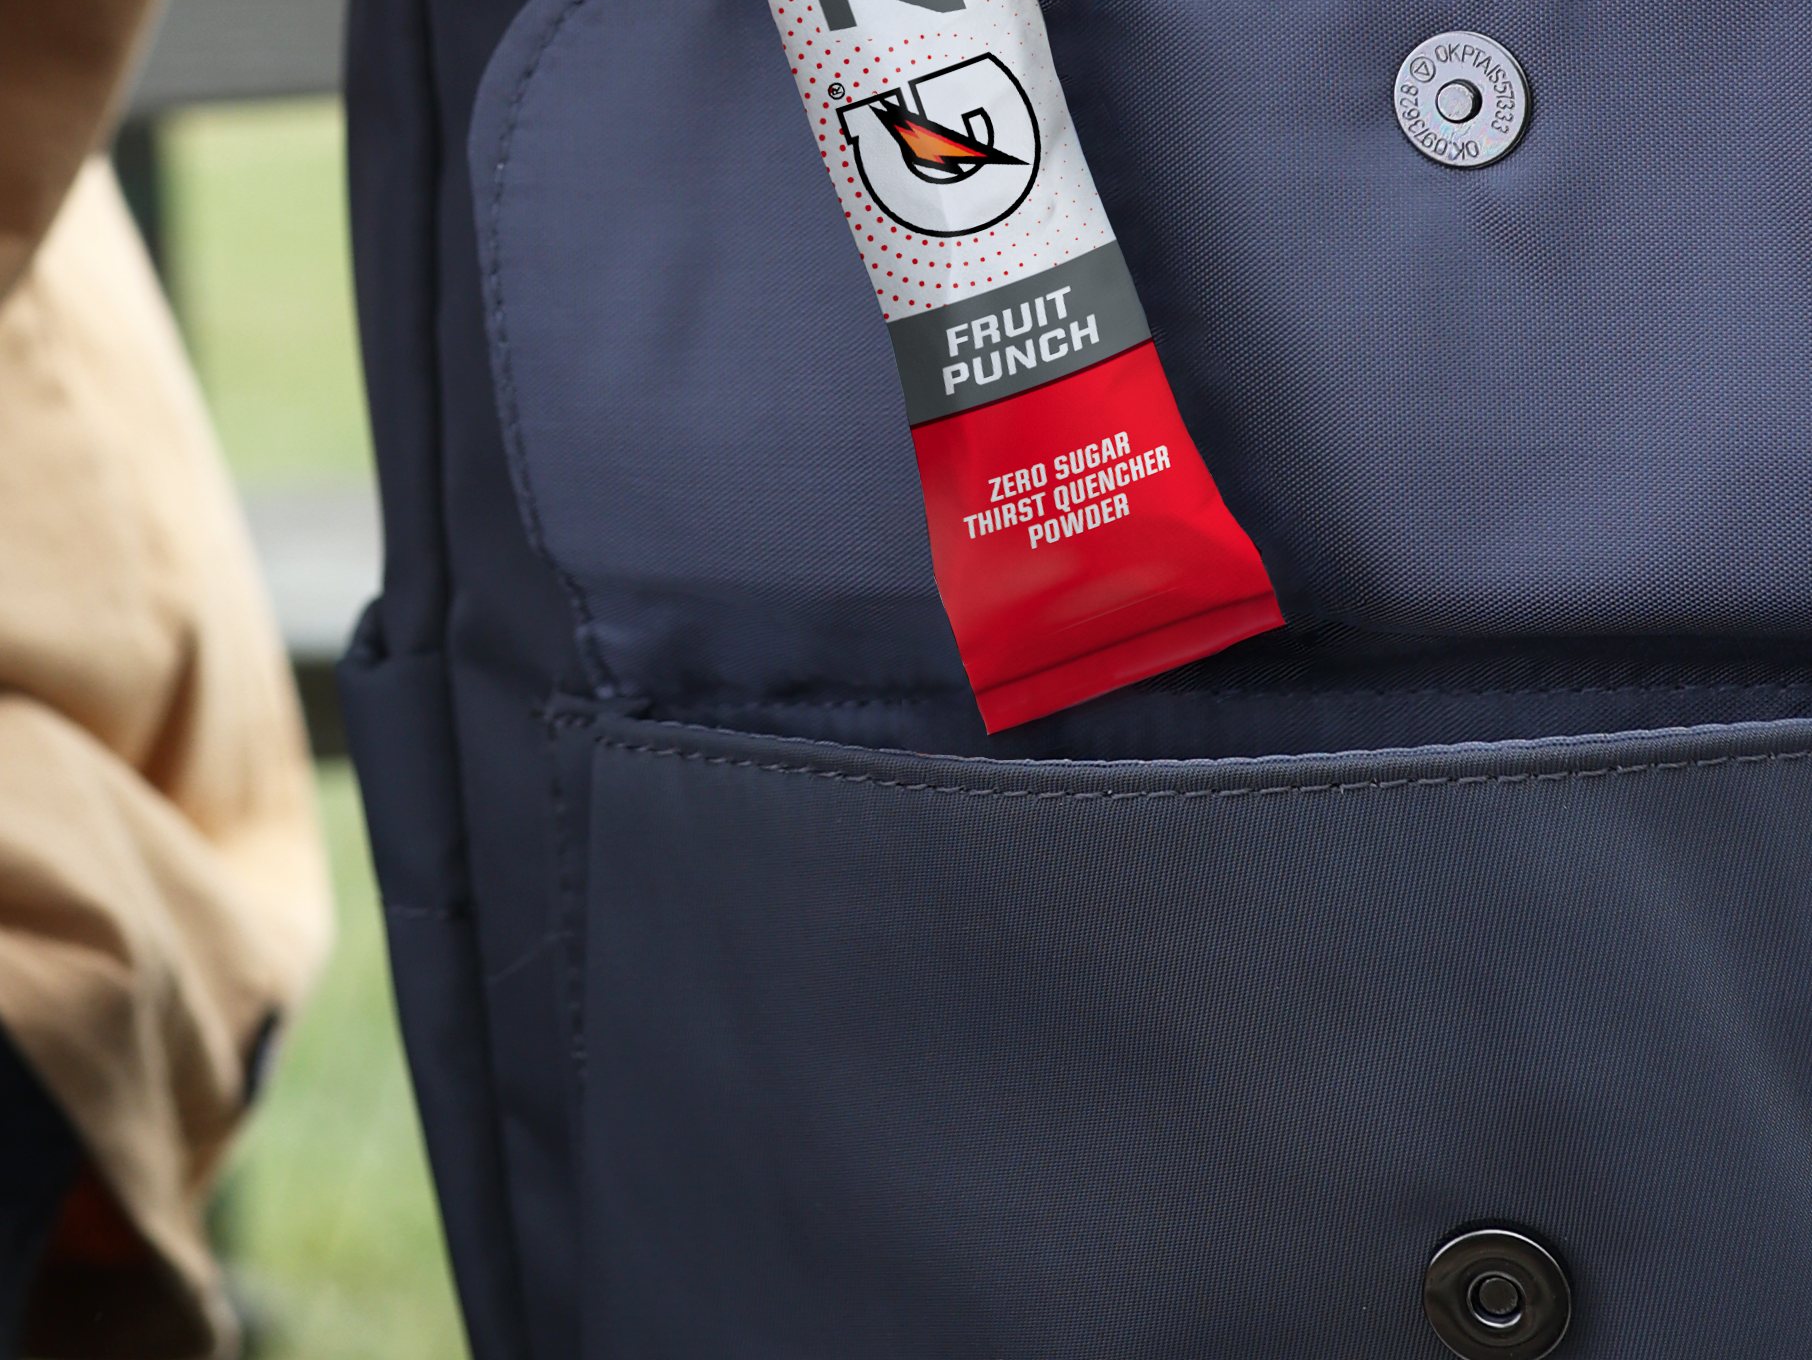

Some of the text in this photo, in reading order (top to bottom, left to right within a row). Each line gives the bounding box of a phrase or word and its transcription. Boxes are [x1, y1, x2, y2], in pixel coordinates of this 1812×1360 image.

[942, 313, 1100, 395] PUNCH
[946, 286, 1071, 357] FRUIT
[963, 444, 1171, 539] THIRST QUENCHER
[988, 431, 1131, 502] ZERO SUGAR
[1028, 493, 1130, 549] POWDER
